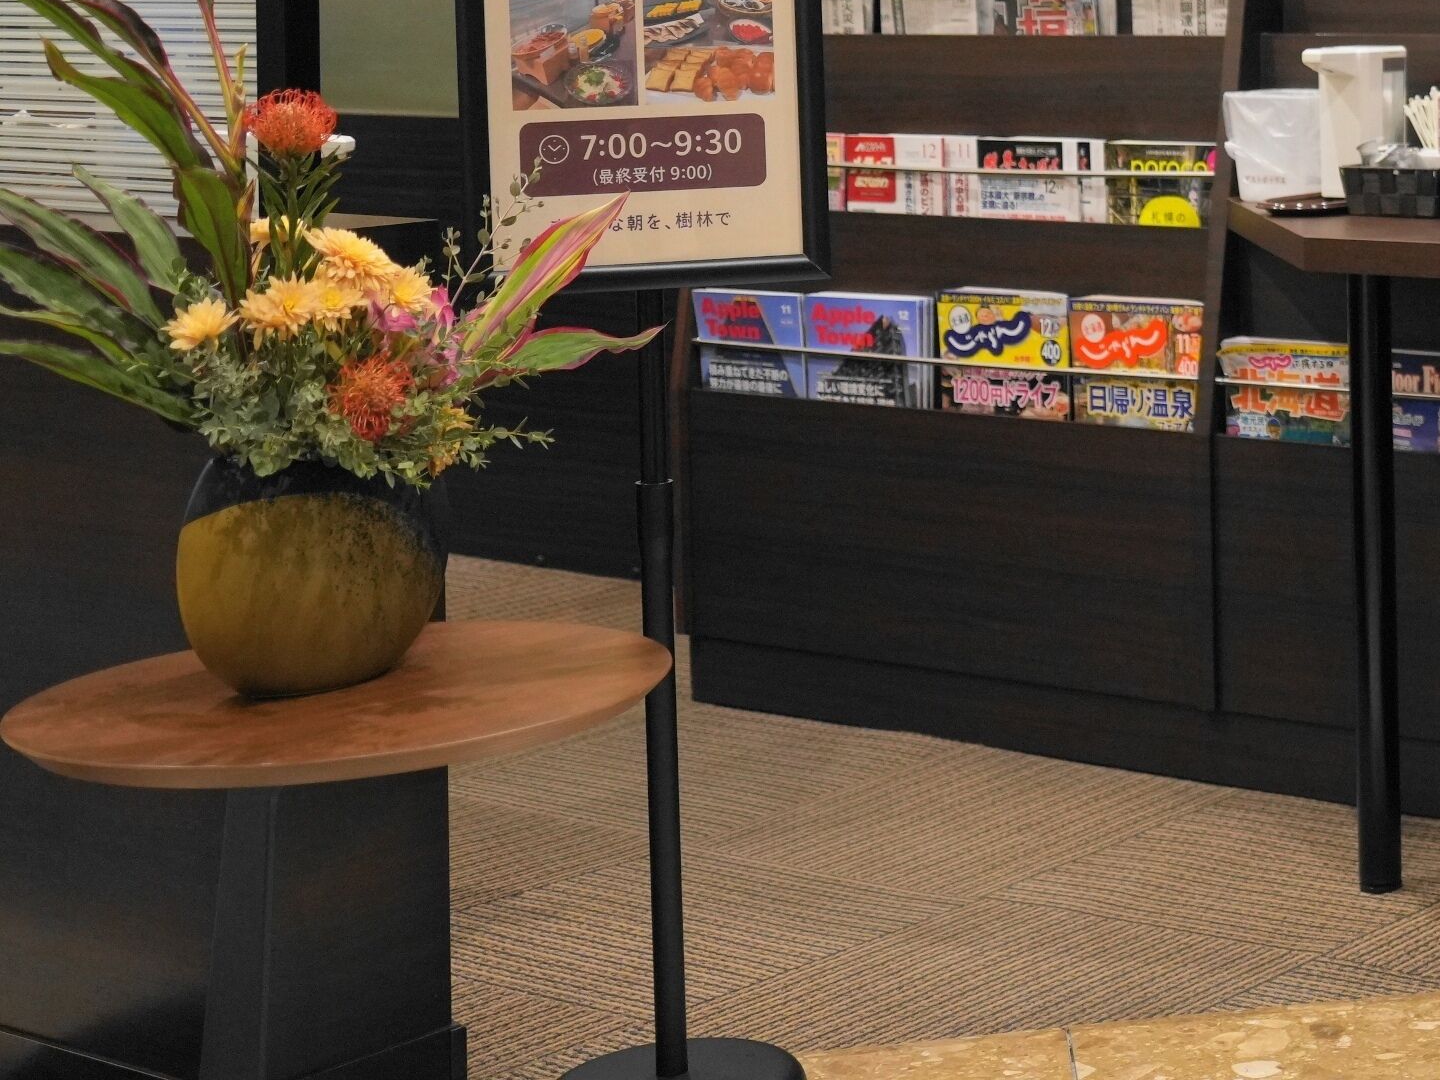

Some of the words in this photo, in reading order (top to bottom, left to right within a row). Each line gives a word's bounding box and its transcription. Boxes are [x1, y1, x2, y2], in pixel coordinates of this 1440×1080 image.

[702, 297, 762, 322] Apple
[811, 302, 876, 327] Apple
[705, 318, 761, 340] Town
[816, 323, 875, 348] Town
[947, 317, 1027, 352] じゃらん
[1079, 328, 1161, 362] じゃらん
[1088, 384, 1194, 418] 日帰り温泉
